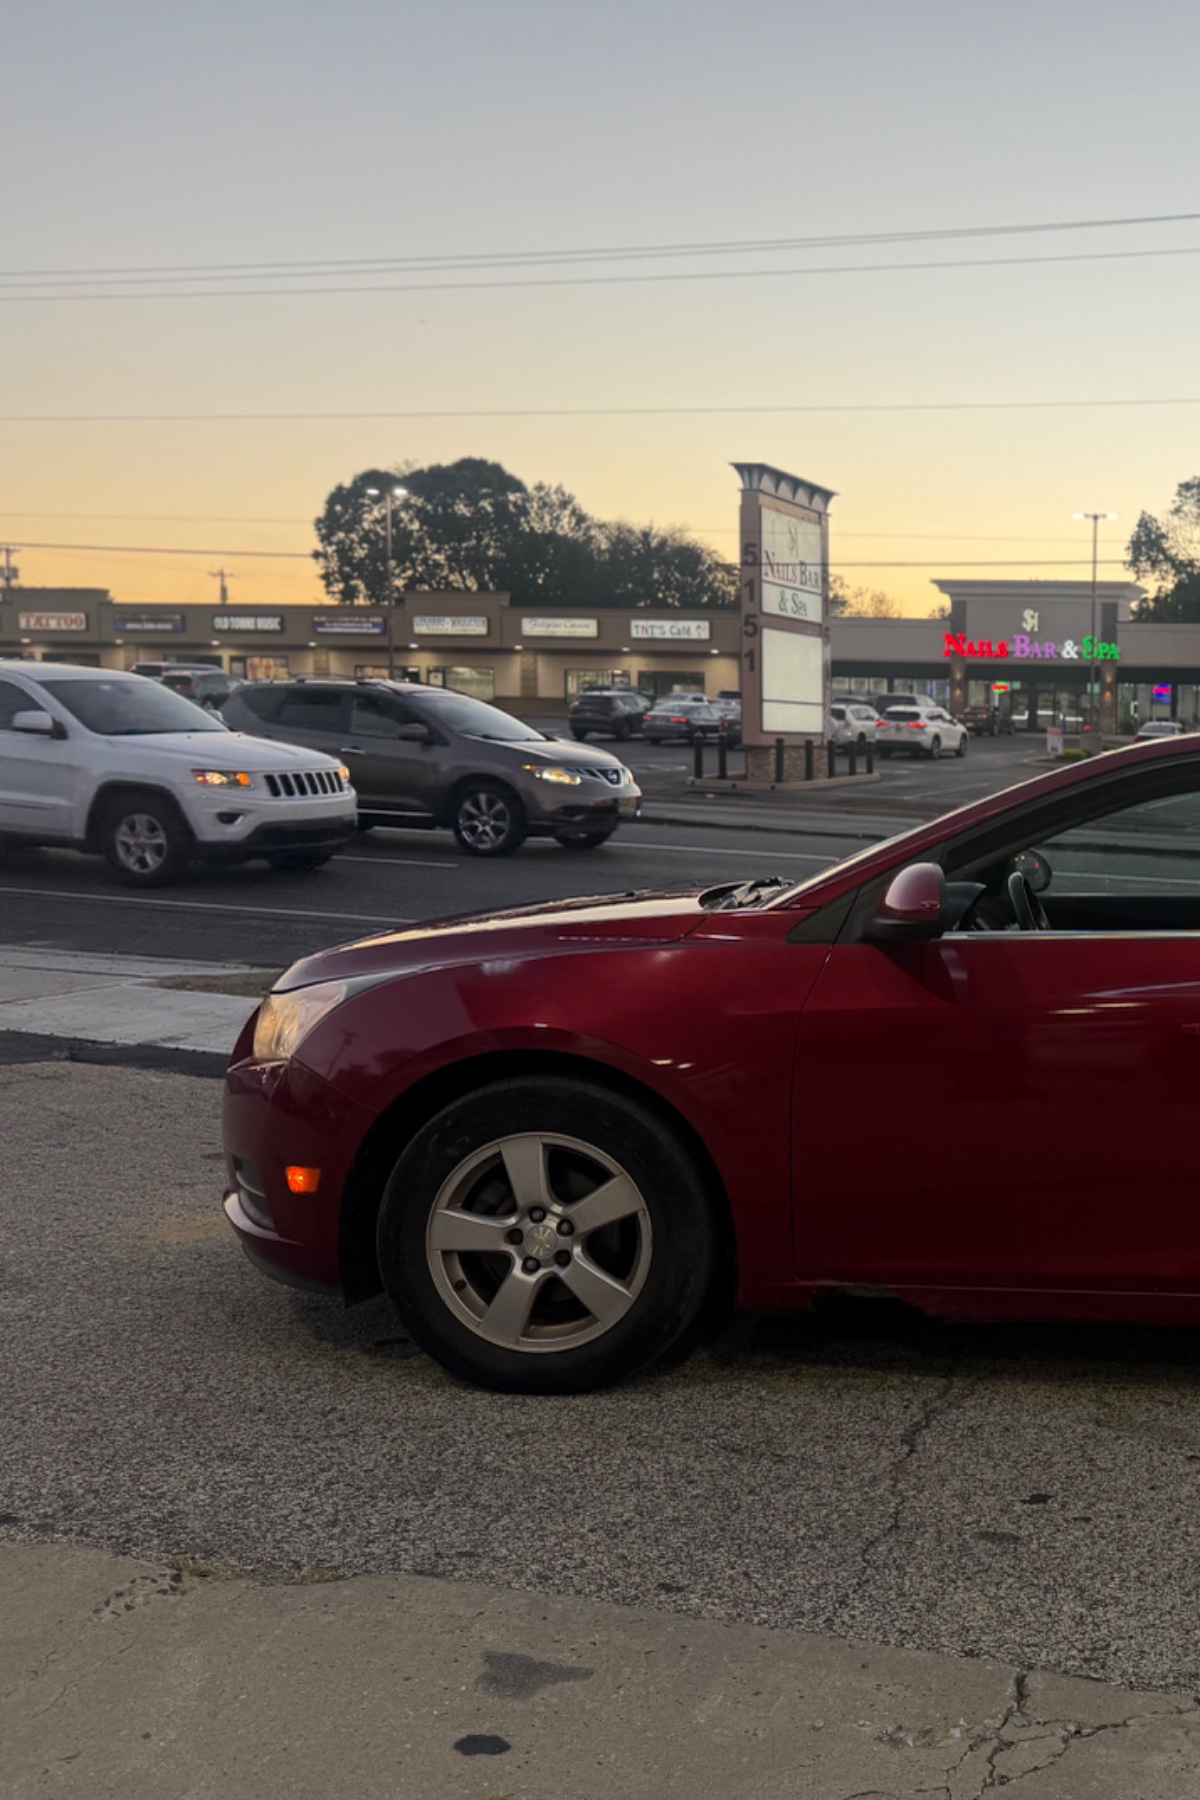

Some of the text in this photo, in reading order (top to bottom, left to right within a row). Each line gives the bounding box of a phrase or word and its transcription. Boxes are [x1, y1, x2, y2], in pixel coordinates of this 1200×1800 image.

[743, 542, 759, 674] 5151
[778, 589, 789, 613] &
[21, 613, 84, 629] TATTOO
[942, 632, 1009, 659] NAILS
[1013, 634, 1057, 659] BAR
[1061, 639, 1079, 660] &
